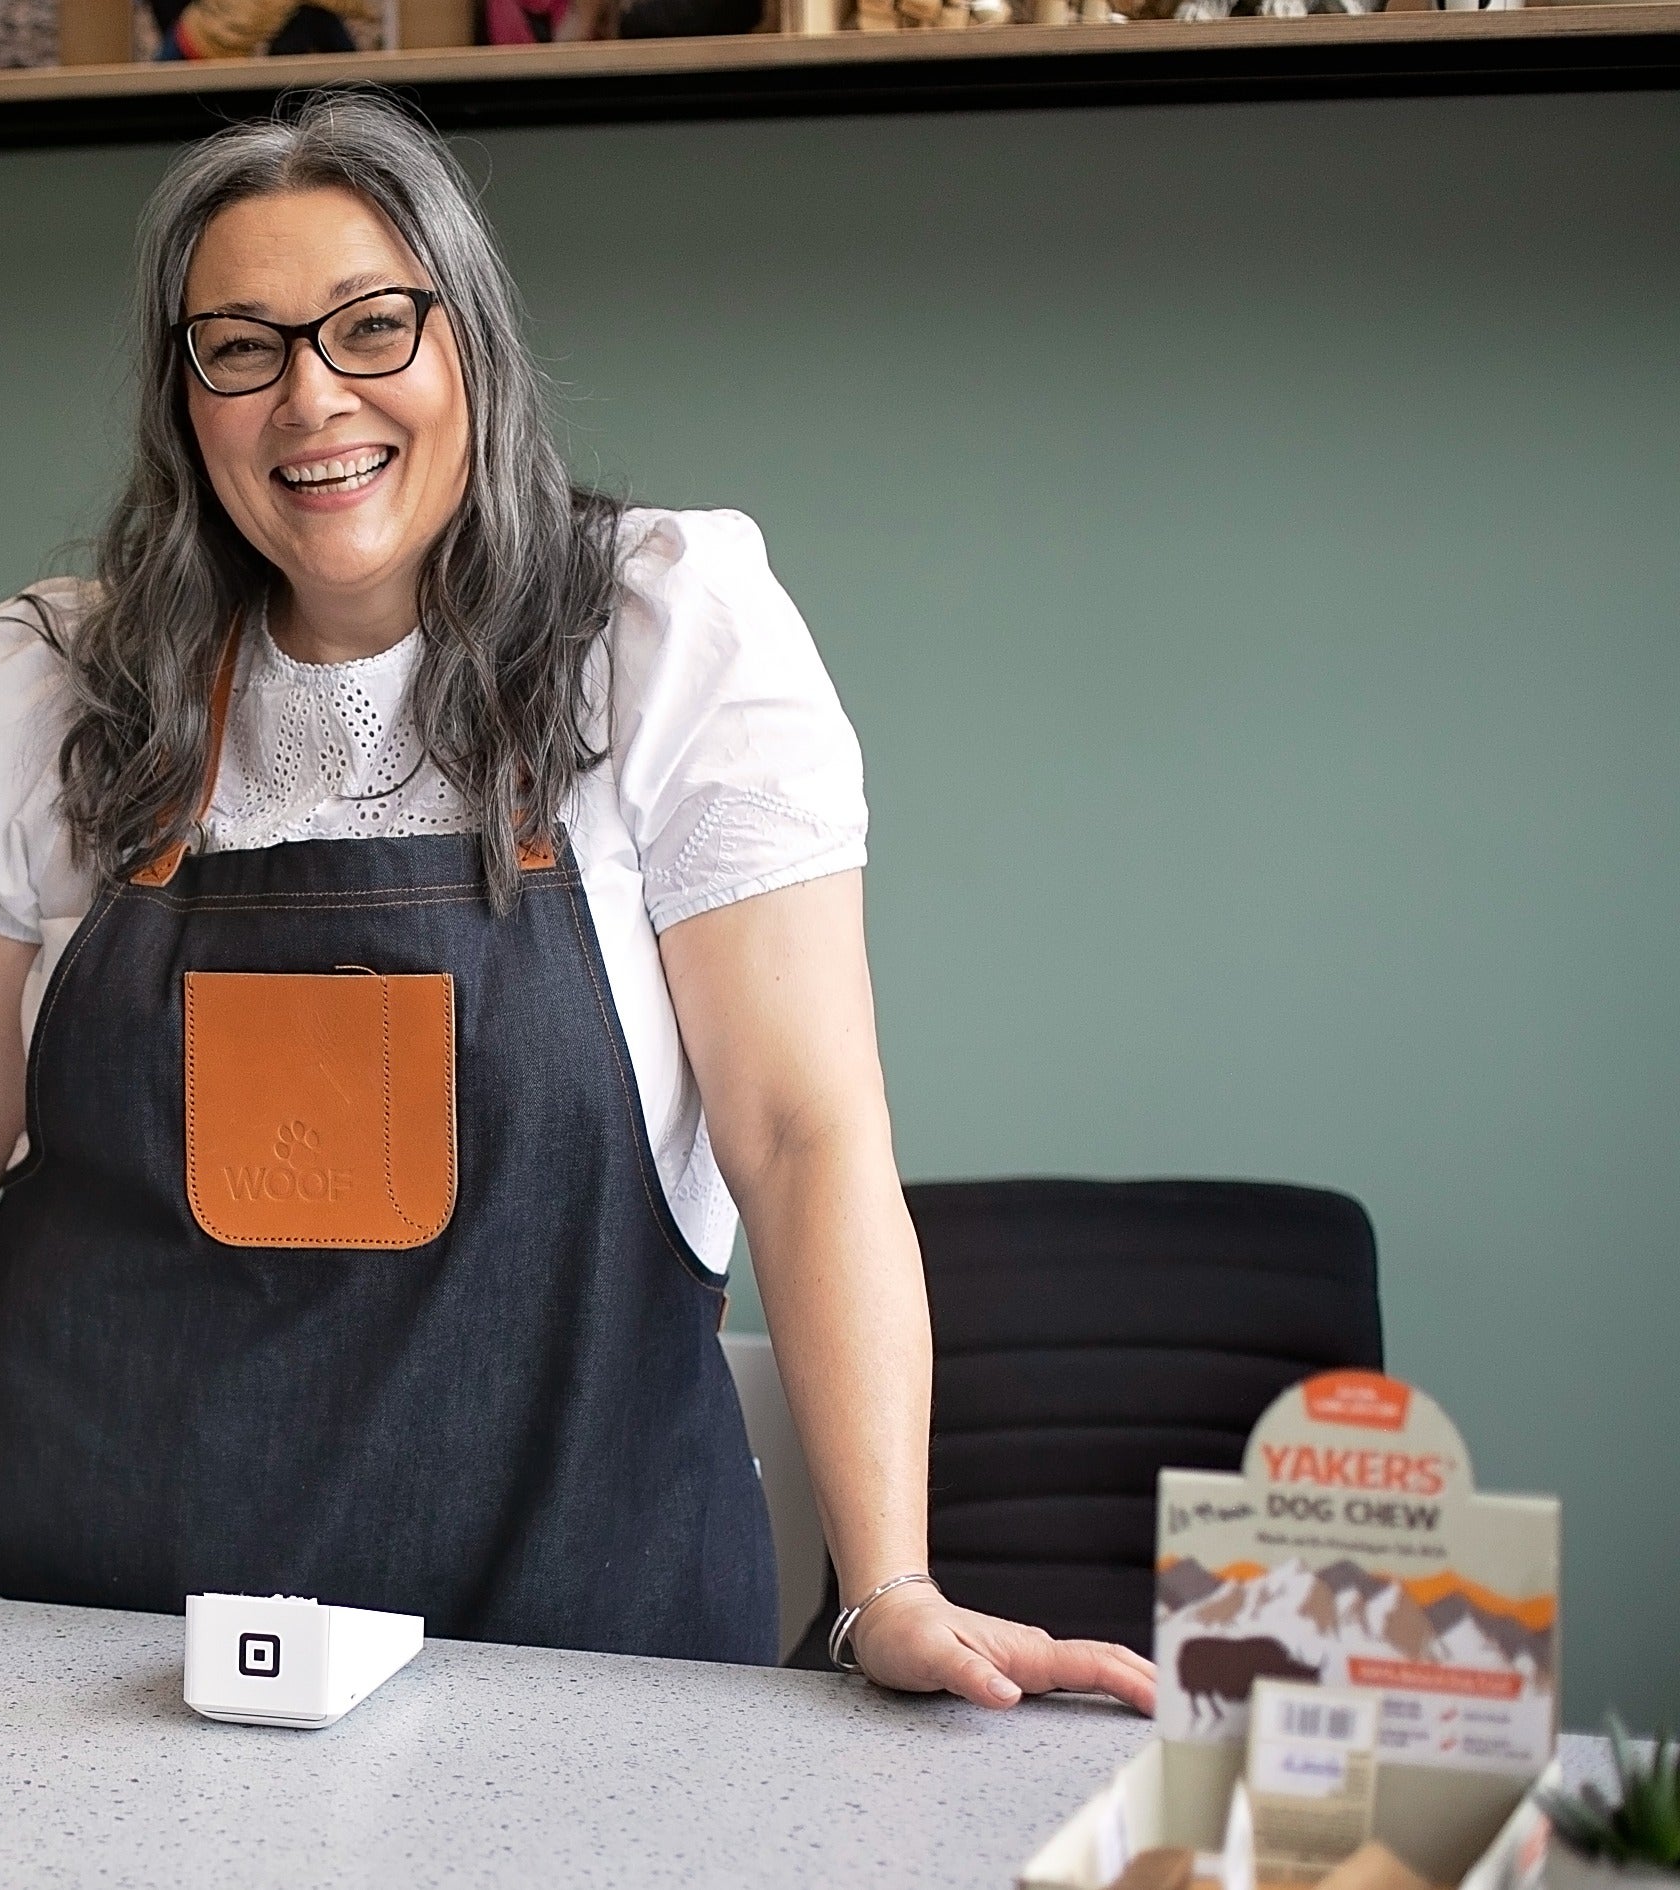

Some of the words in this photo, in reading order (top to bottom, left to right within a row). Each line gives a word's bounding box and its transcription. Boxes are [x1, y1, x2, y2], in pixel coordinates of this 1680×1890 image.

[223, 1165, 354, 1202] WOOF
[1261, 1443, 1446, 1497] YAKERS
[1266, 1494, 1336, 1523] DOG
[1343, 1501, 1441, 1532] CHEW
